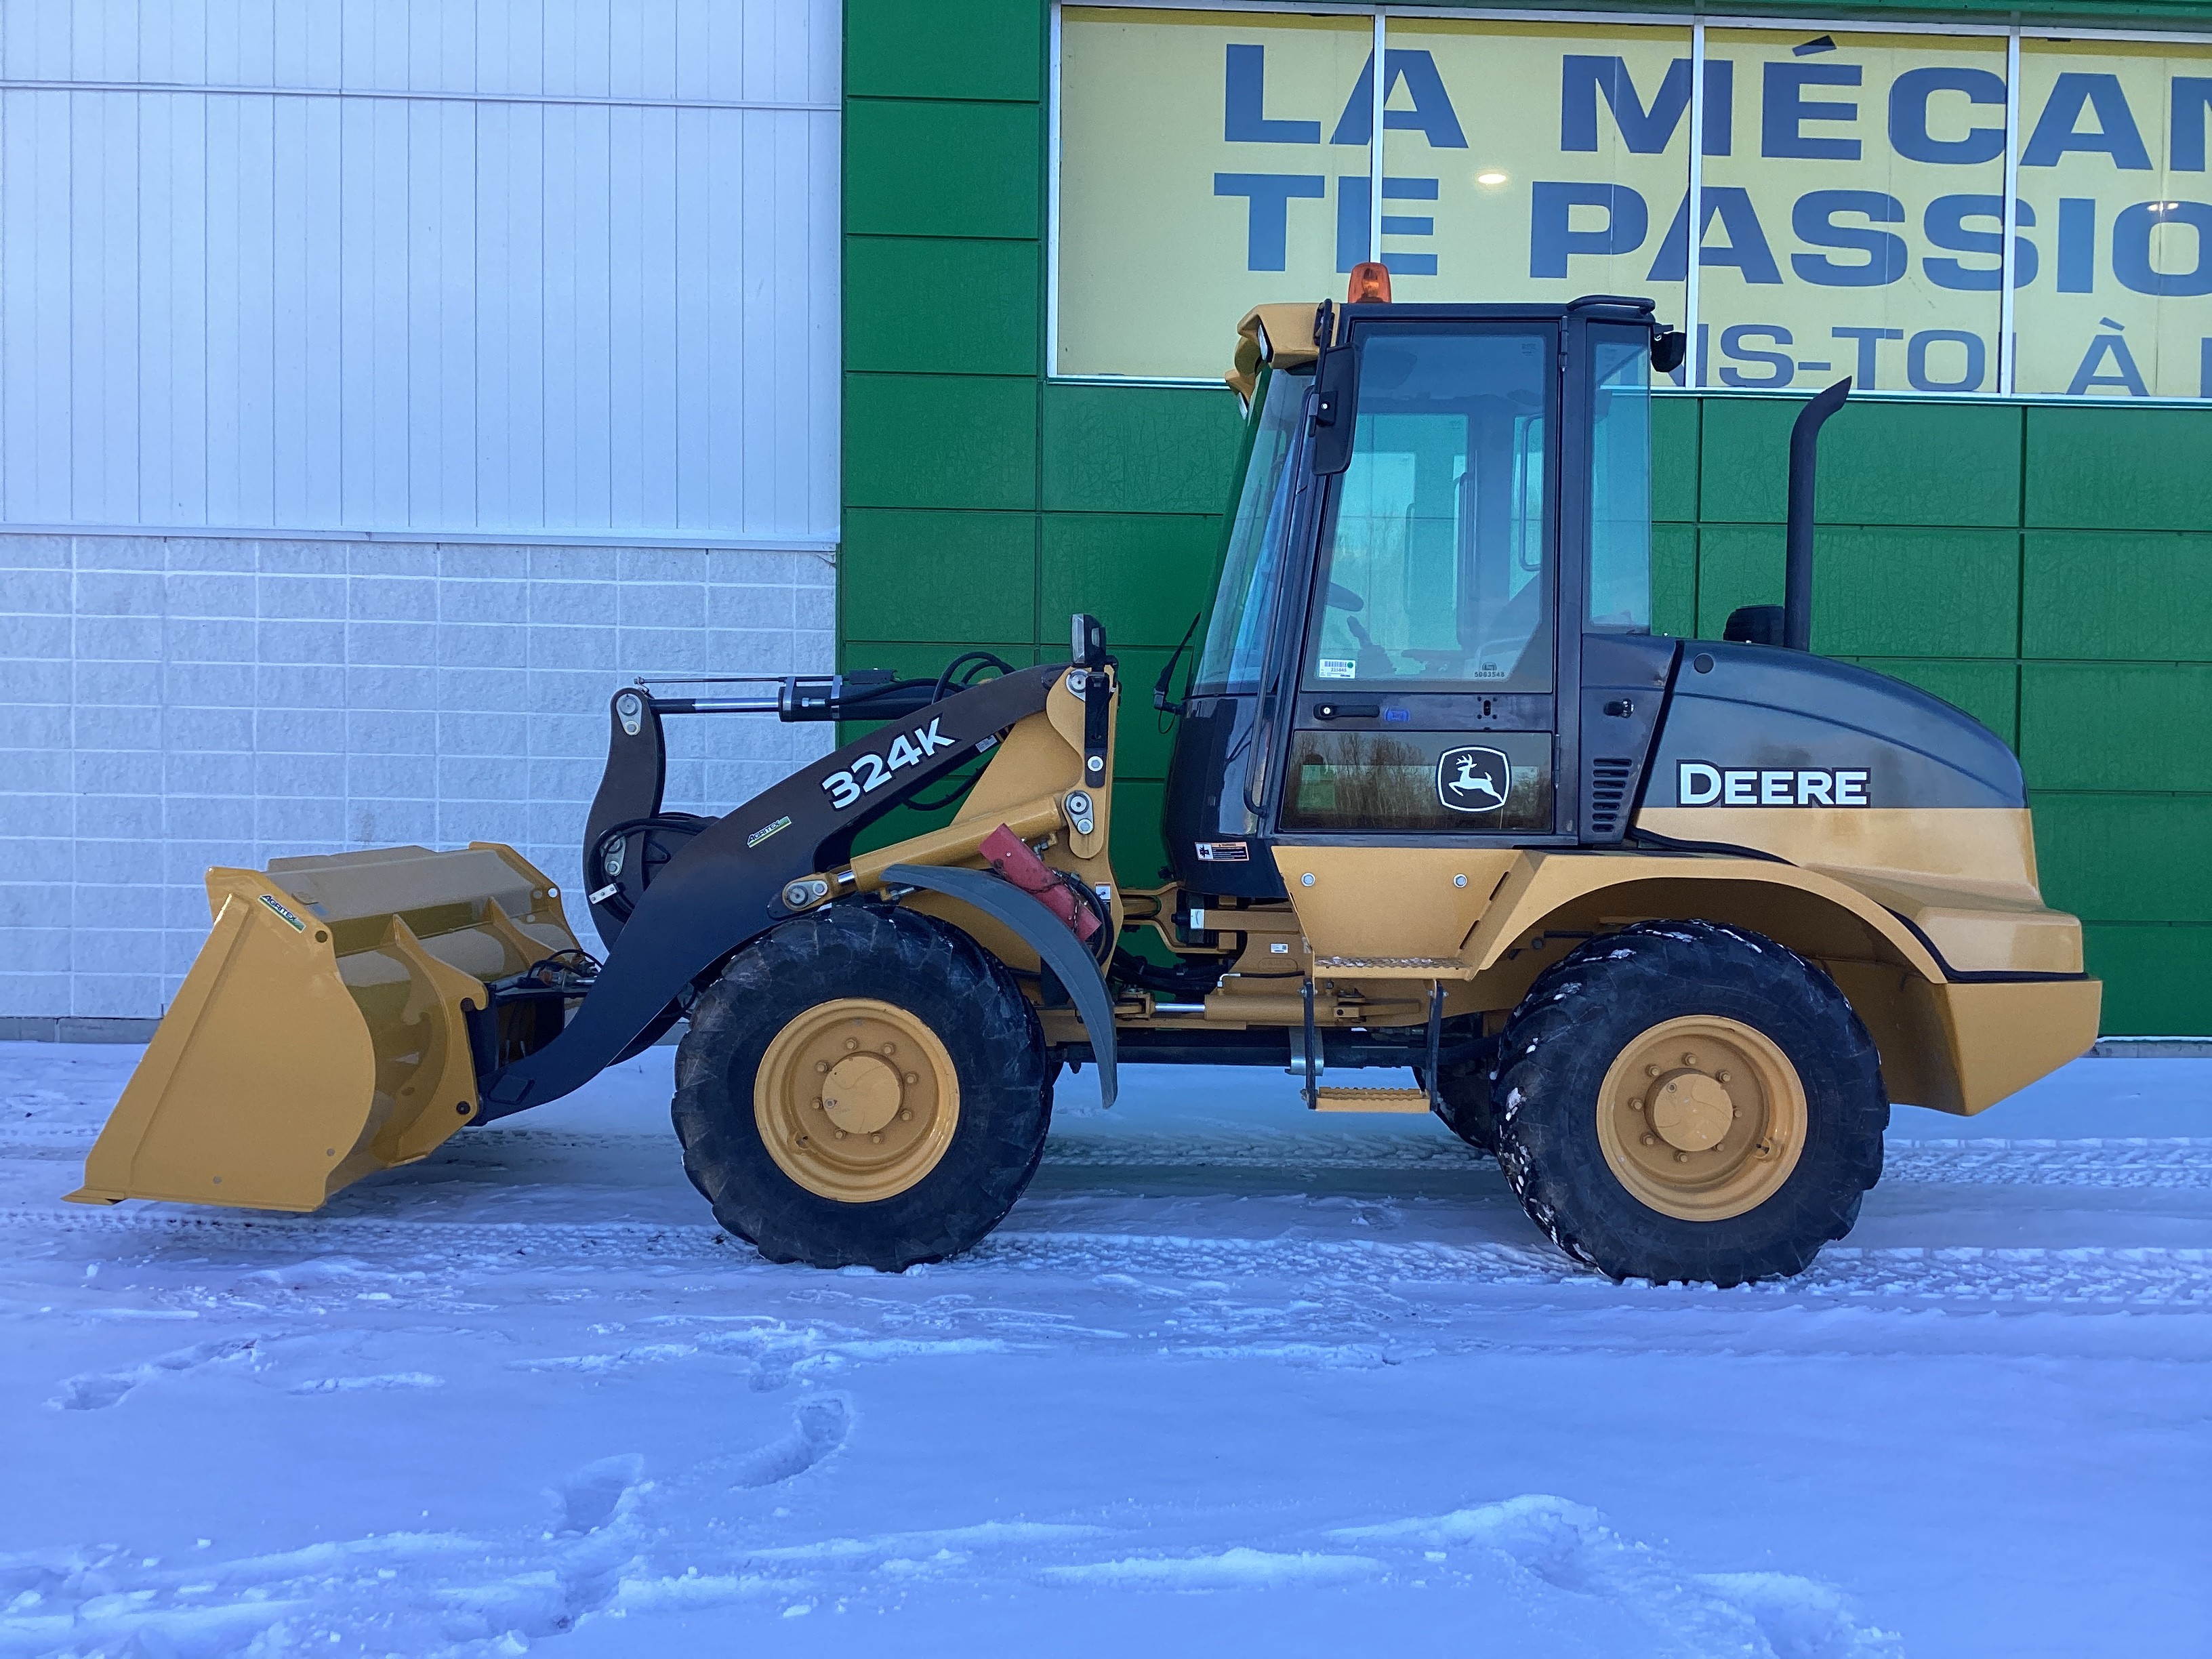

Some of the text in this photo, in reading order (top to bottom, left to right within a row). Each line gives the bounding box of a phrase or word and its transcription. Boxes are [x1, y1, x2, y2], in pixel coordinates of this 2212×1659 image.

[1224, 43, 1469, 148] LA
[1214, 172, 2212, 298] TE PASSIO
[2065, 316, 2150, 396] À
[821, 716, 956, 810] 324K
[1679, 763, 1868, 805] DEERE
[747, 820, 780, 844] AGRITEX
[261, 895, 298, 922] AGRITEX
